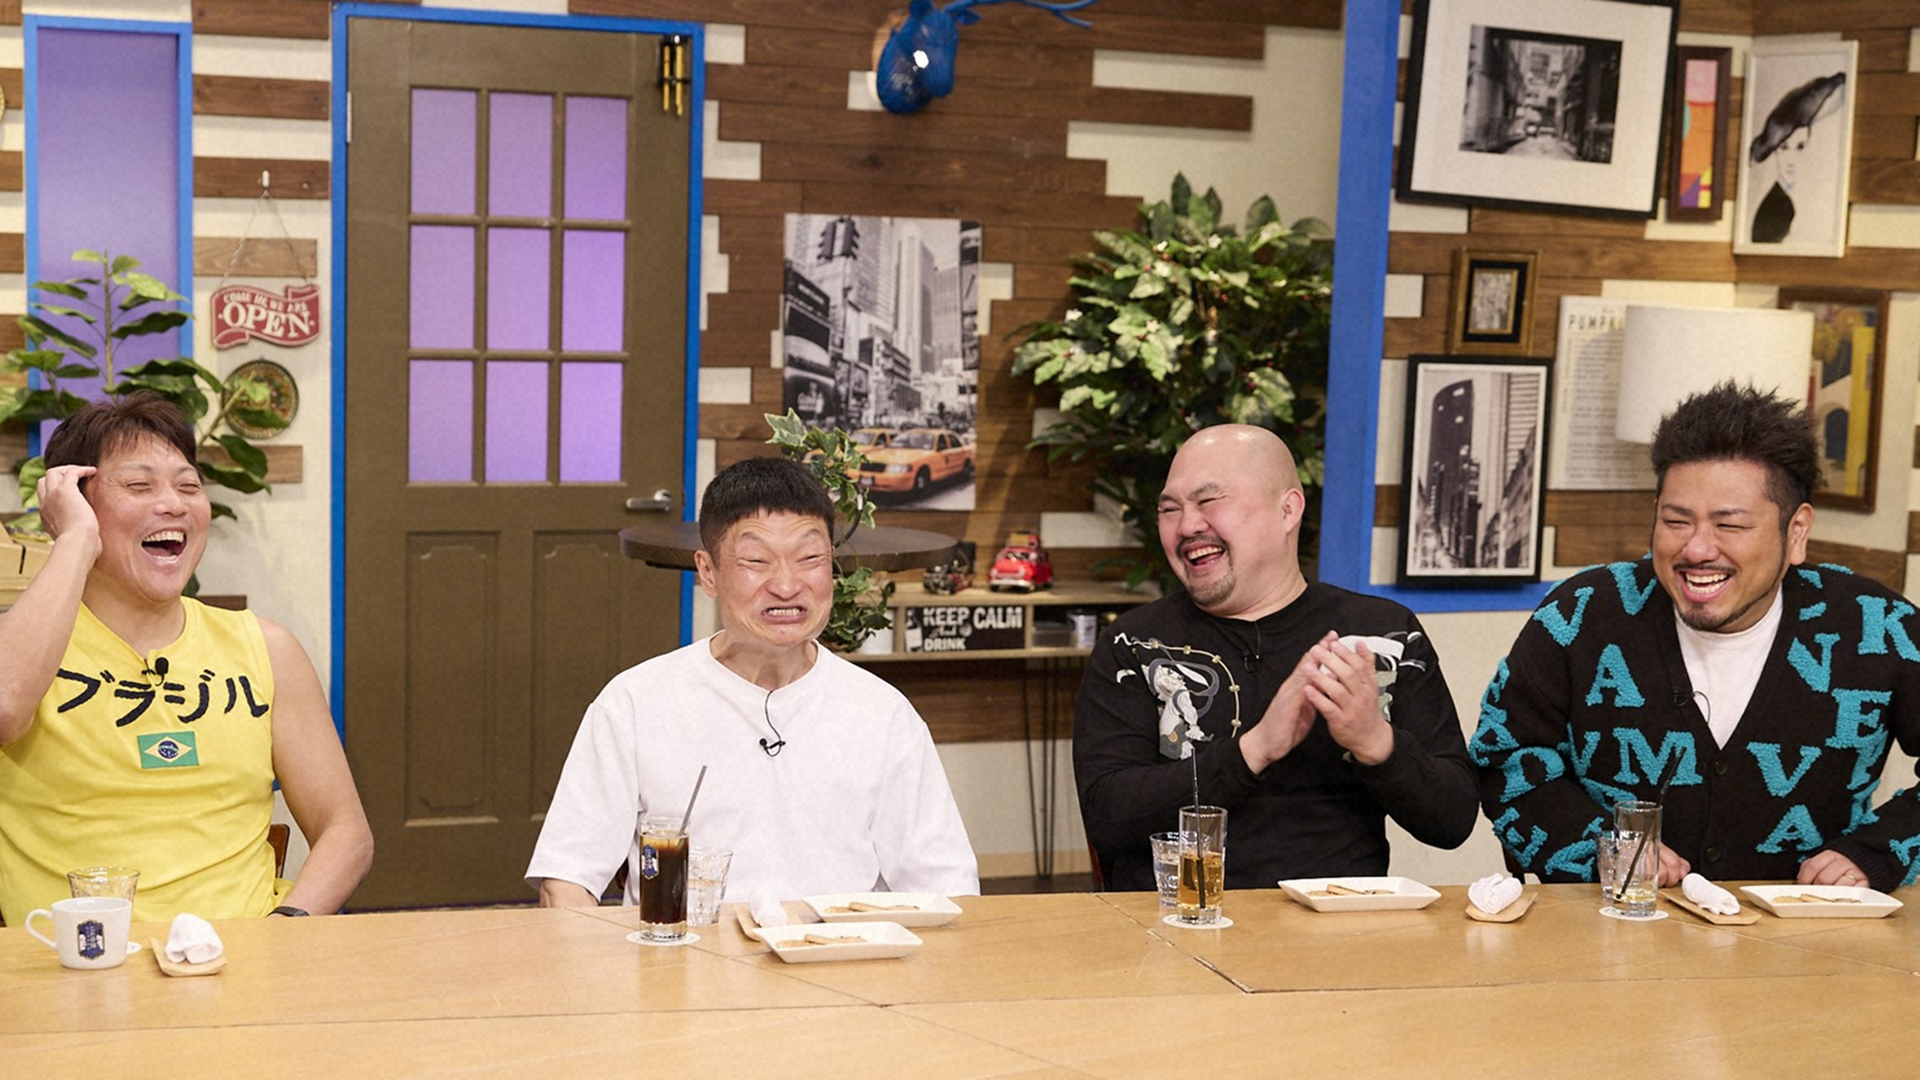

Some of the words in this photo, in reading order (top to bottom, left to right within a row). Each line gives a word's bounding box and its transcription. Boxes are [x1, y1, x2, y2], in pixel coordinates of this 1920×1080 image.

[223, 302, 311, 338] OPEN
[923, 607, 970, 626] KEEP
[973, 607, 1023, 630] CALM
[924, 638, 966, 652] DRINK
[1534, 587, 1594, 647] V
[1856, 595, 1920, 662] K
[57, 668, 270, 728] ブラジル
[1585, 643, 1645, 708] A
[1825, 688, 1892, 749] E
[1612, 726, 1704, 786] M
[1746, 741, 1822, 798] V
[1756, 804, 1824, 854] A
